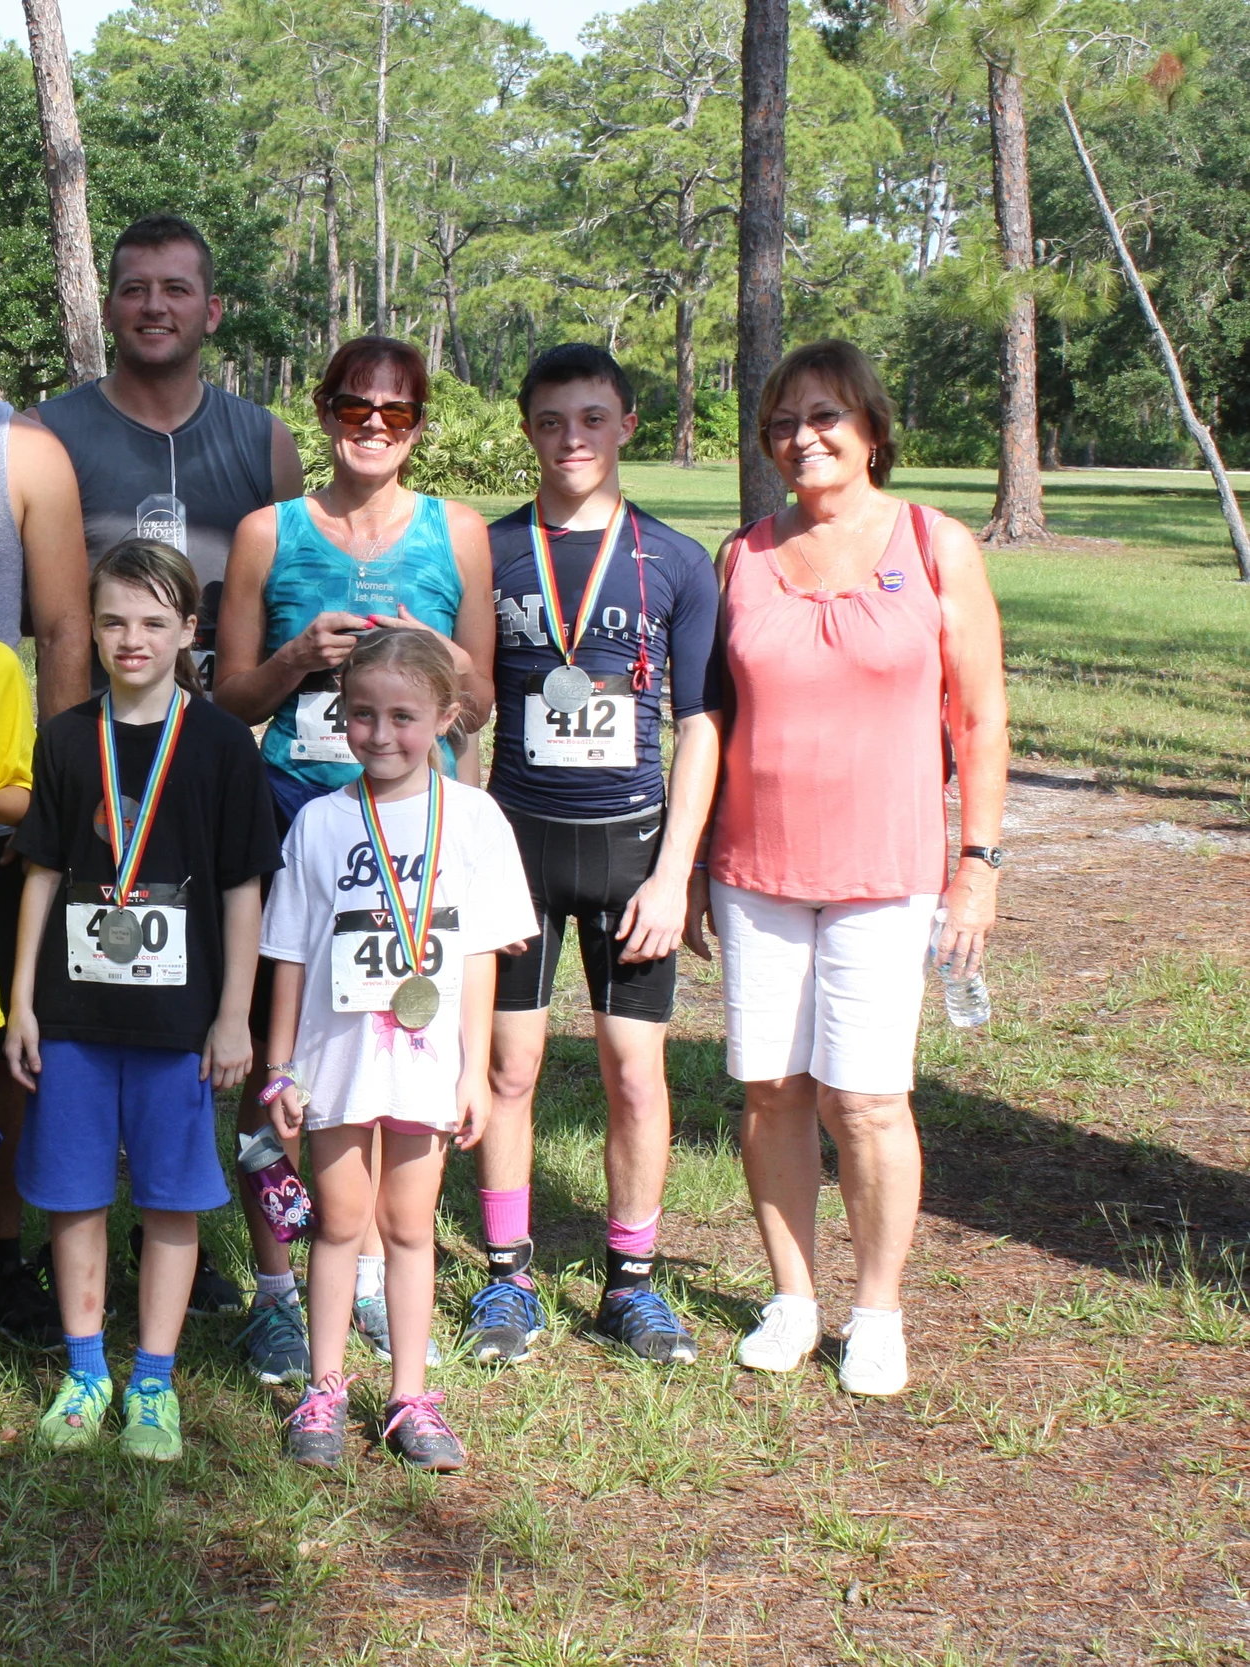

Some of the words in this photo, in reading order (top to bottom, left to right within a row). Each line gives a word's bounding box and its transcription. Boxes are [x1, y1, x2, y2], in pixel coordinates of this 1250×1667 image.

[143, 528, 181, 539] HOPE
[355, 580, 394, 591] Womens
[354, 593, 367, 602] 1st
[370, 593, 394, 603] Place
[545, 699, 617, 738] 412
[86, 908, 169, 954] 40
[353, 933, 444, 978] 409
[263, 1080, 283, 1101] cancer
[489, 1252, 514, 1264] ACE
[620, 1261, 653, 1274] ACE
